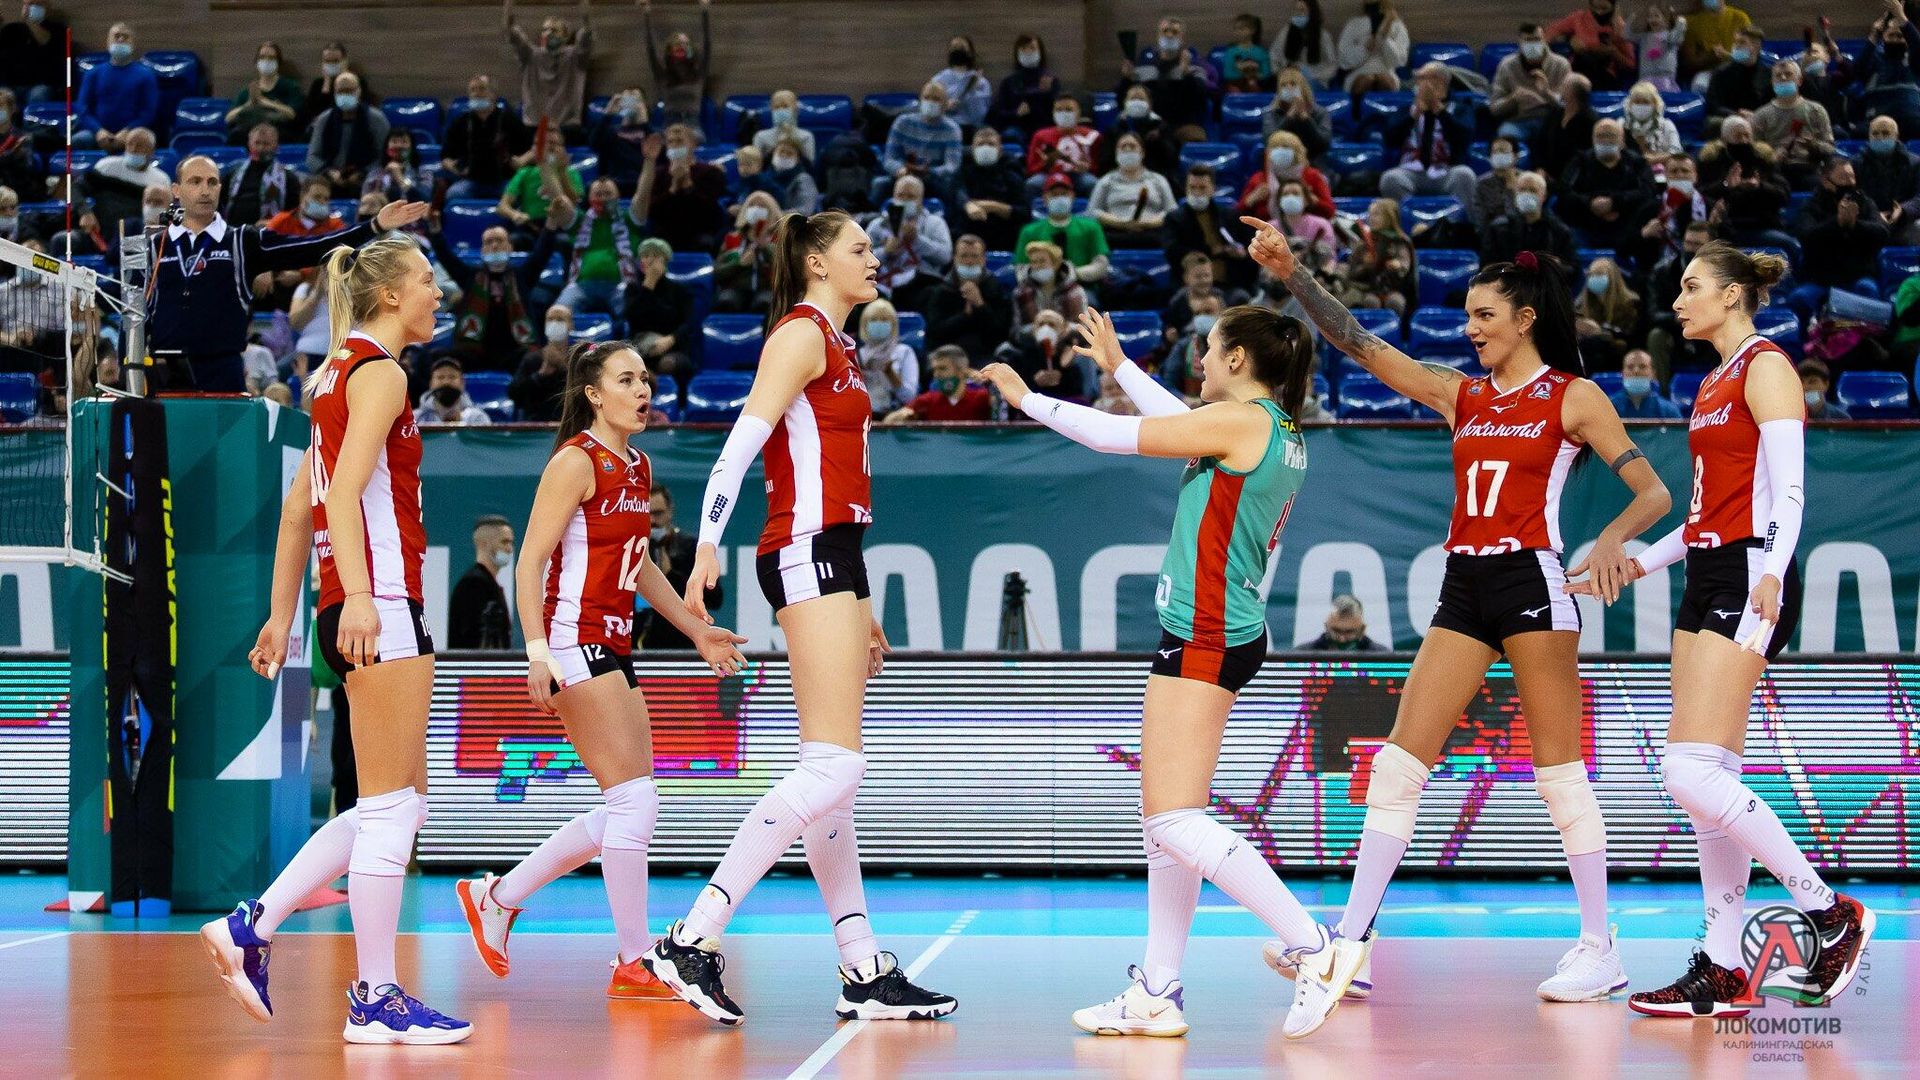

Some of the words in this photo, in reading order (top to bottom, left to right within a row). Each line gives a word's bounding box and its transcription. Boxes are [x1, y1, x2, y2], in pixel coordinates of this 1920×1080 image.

[1466, 460, 1510, 518] 17
[617, 534, 649, 592] 12
[816, 562, 834, 580] 11
[583, 643, 606, 661] 12
